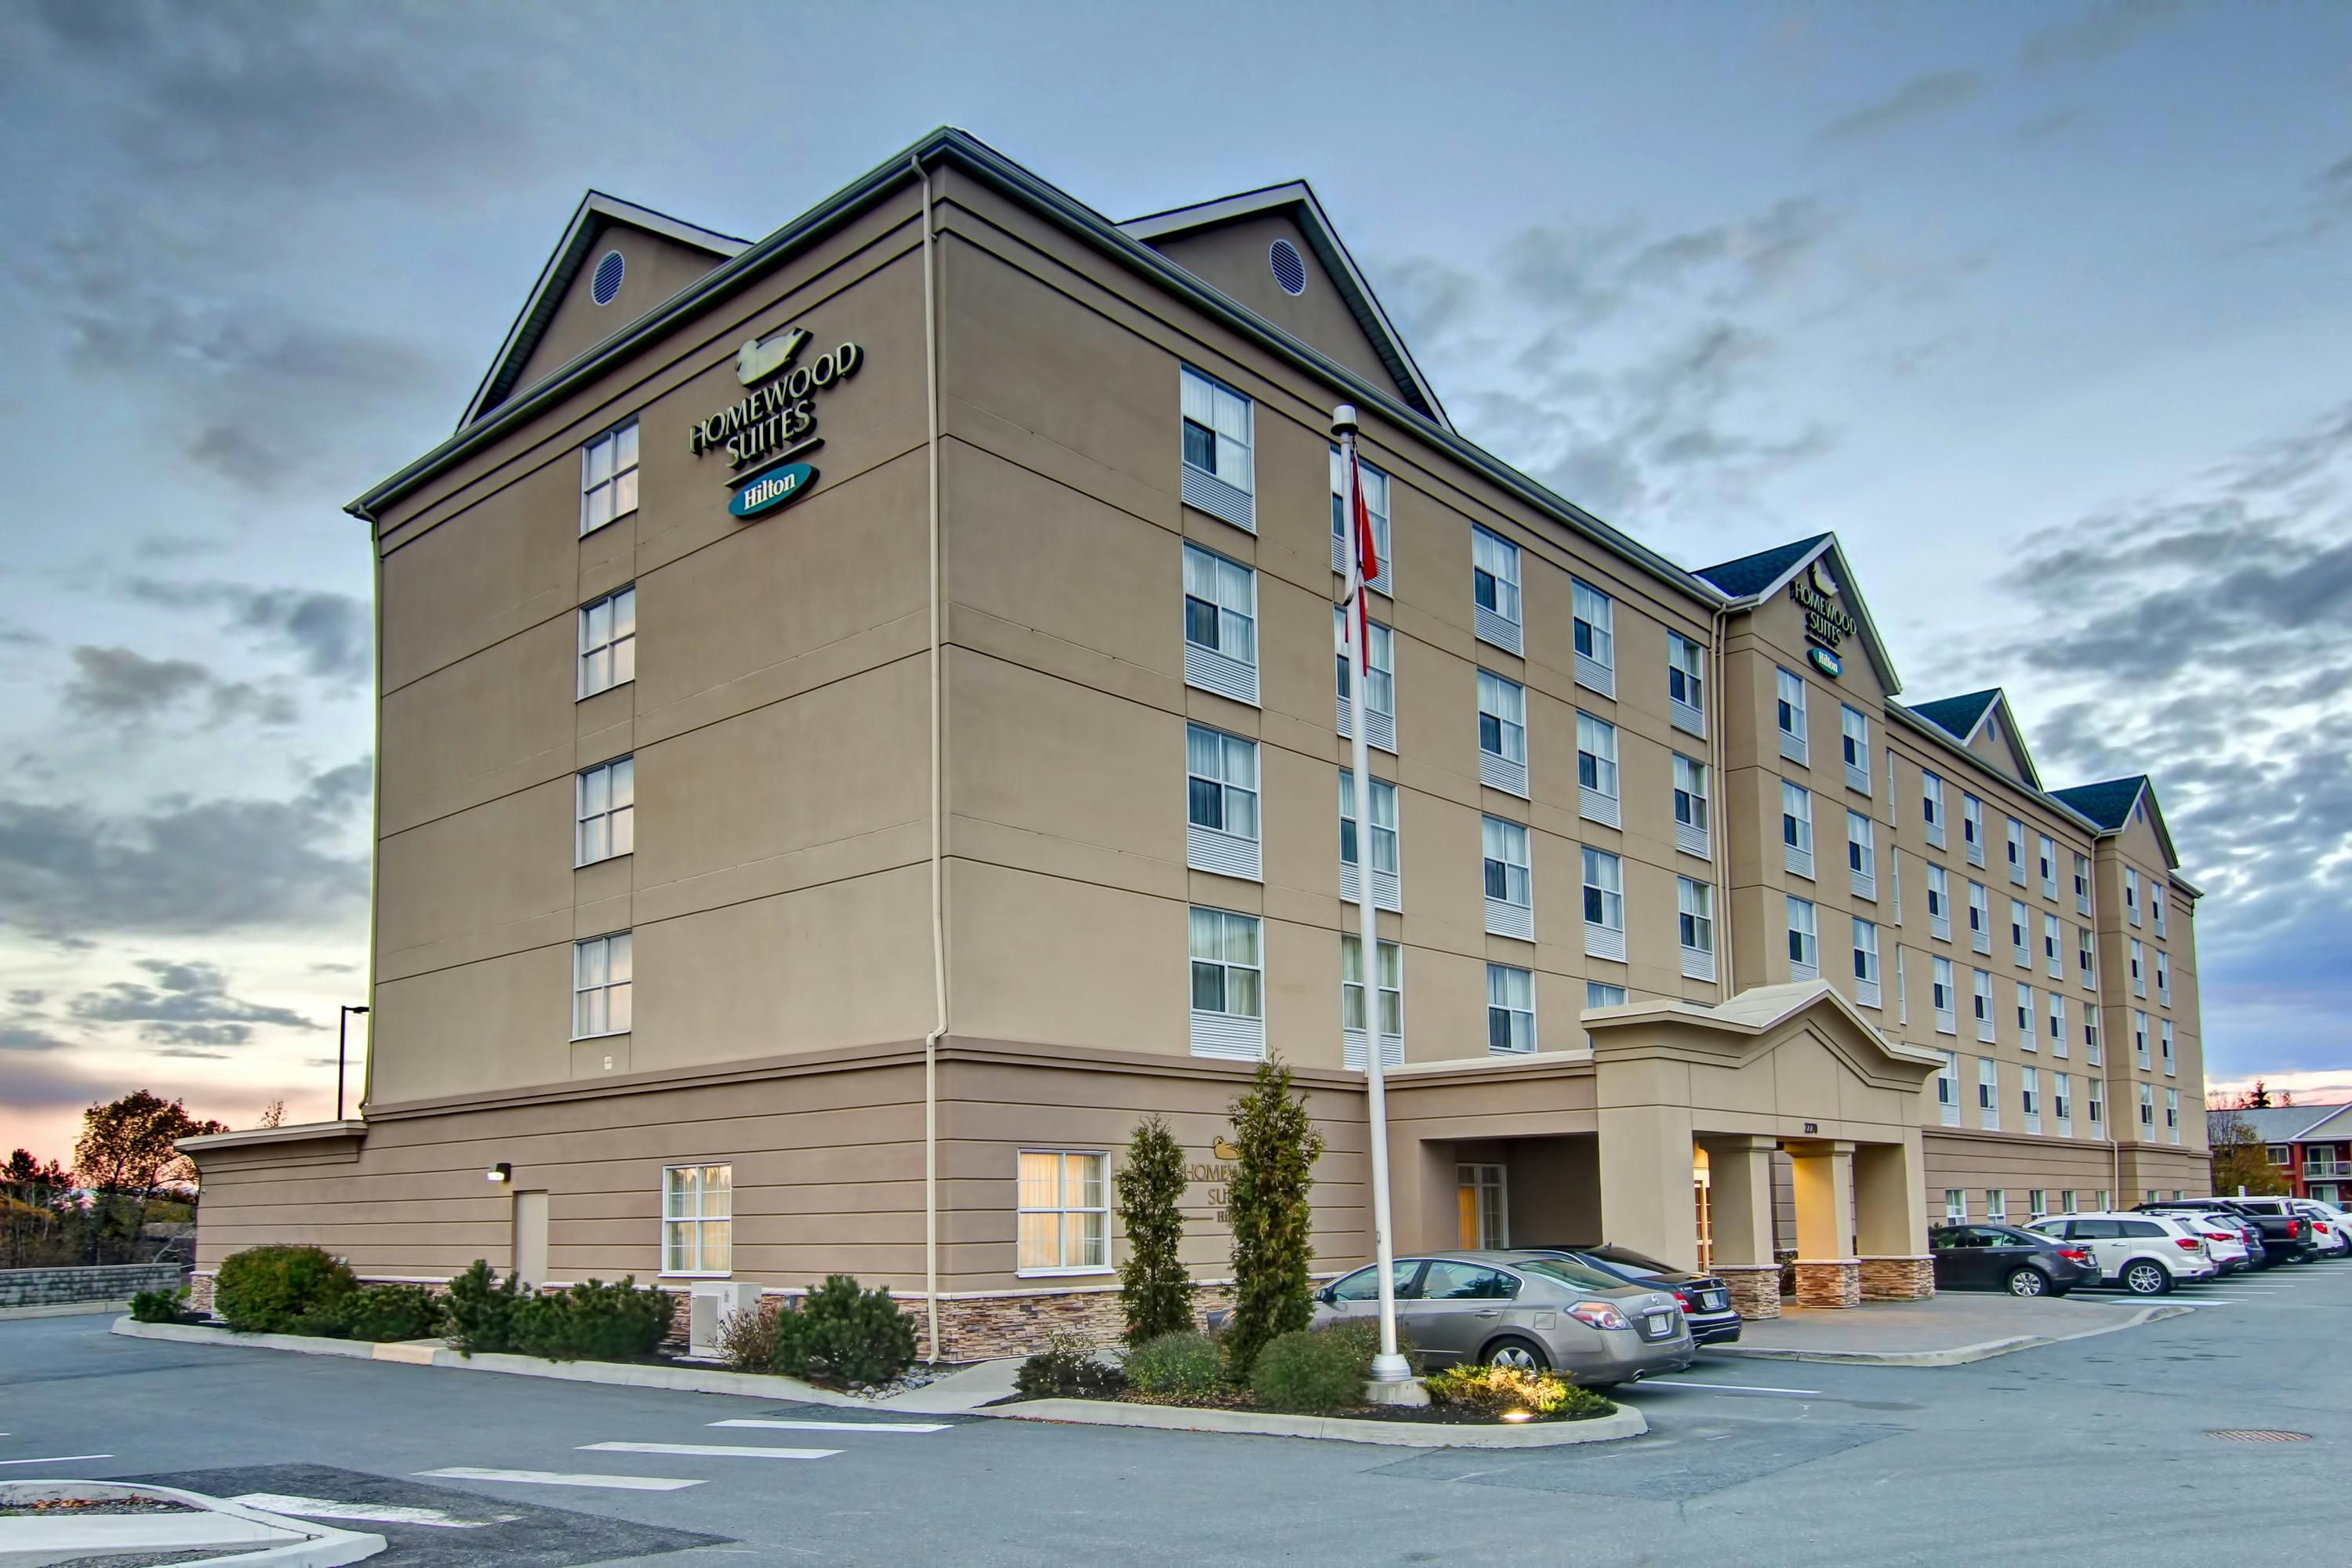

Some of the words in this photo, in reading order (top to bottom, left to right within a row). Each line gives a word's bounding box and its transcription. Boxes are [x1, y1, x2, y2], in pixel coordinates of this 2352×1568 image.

[690, 342, 861, 455] HOMEWOOD
[726, 400, 814, 467] SUITES
[744, 473, 795, 510] Hilton
[1794, 580, 1857, 634] HOMEWOOD
[1809, 611, 1842, 644] SUITES
[1818, 651, 1838, 673] Hilton
[1184, 1163, 1244, 1181] HOMEW
[1208, 1189, 1231, 1206] SUI
